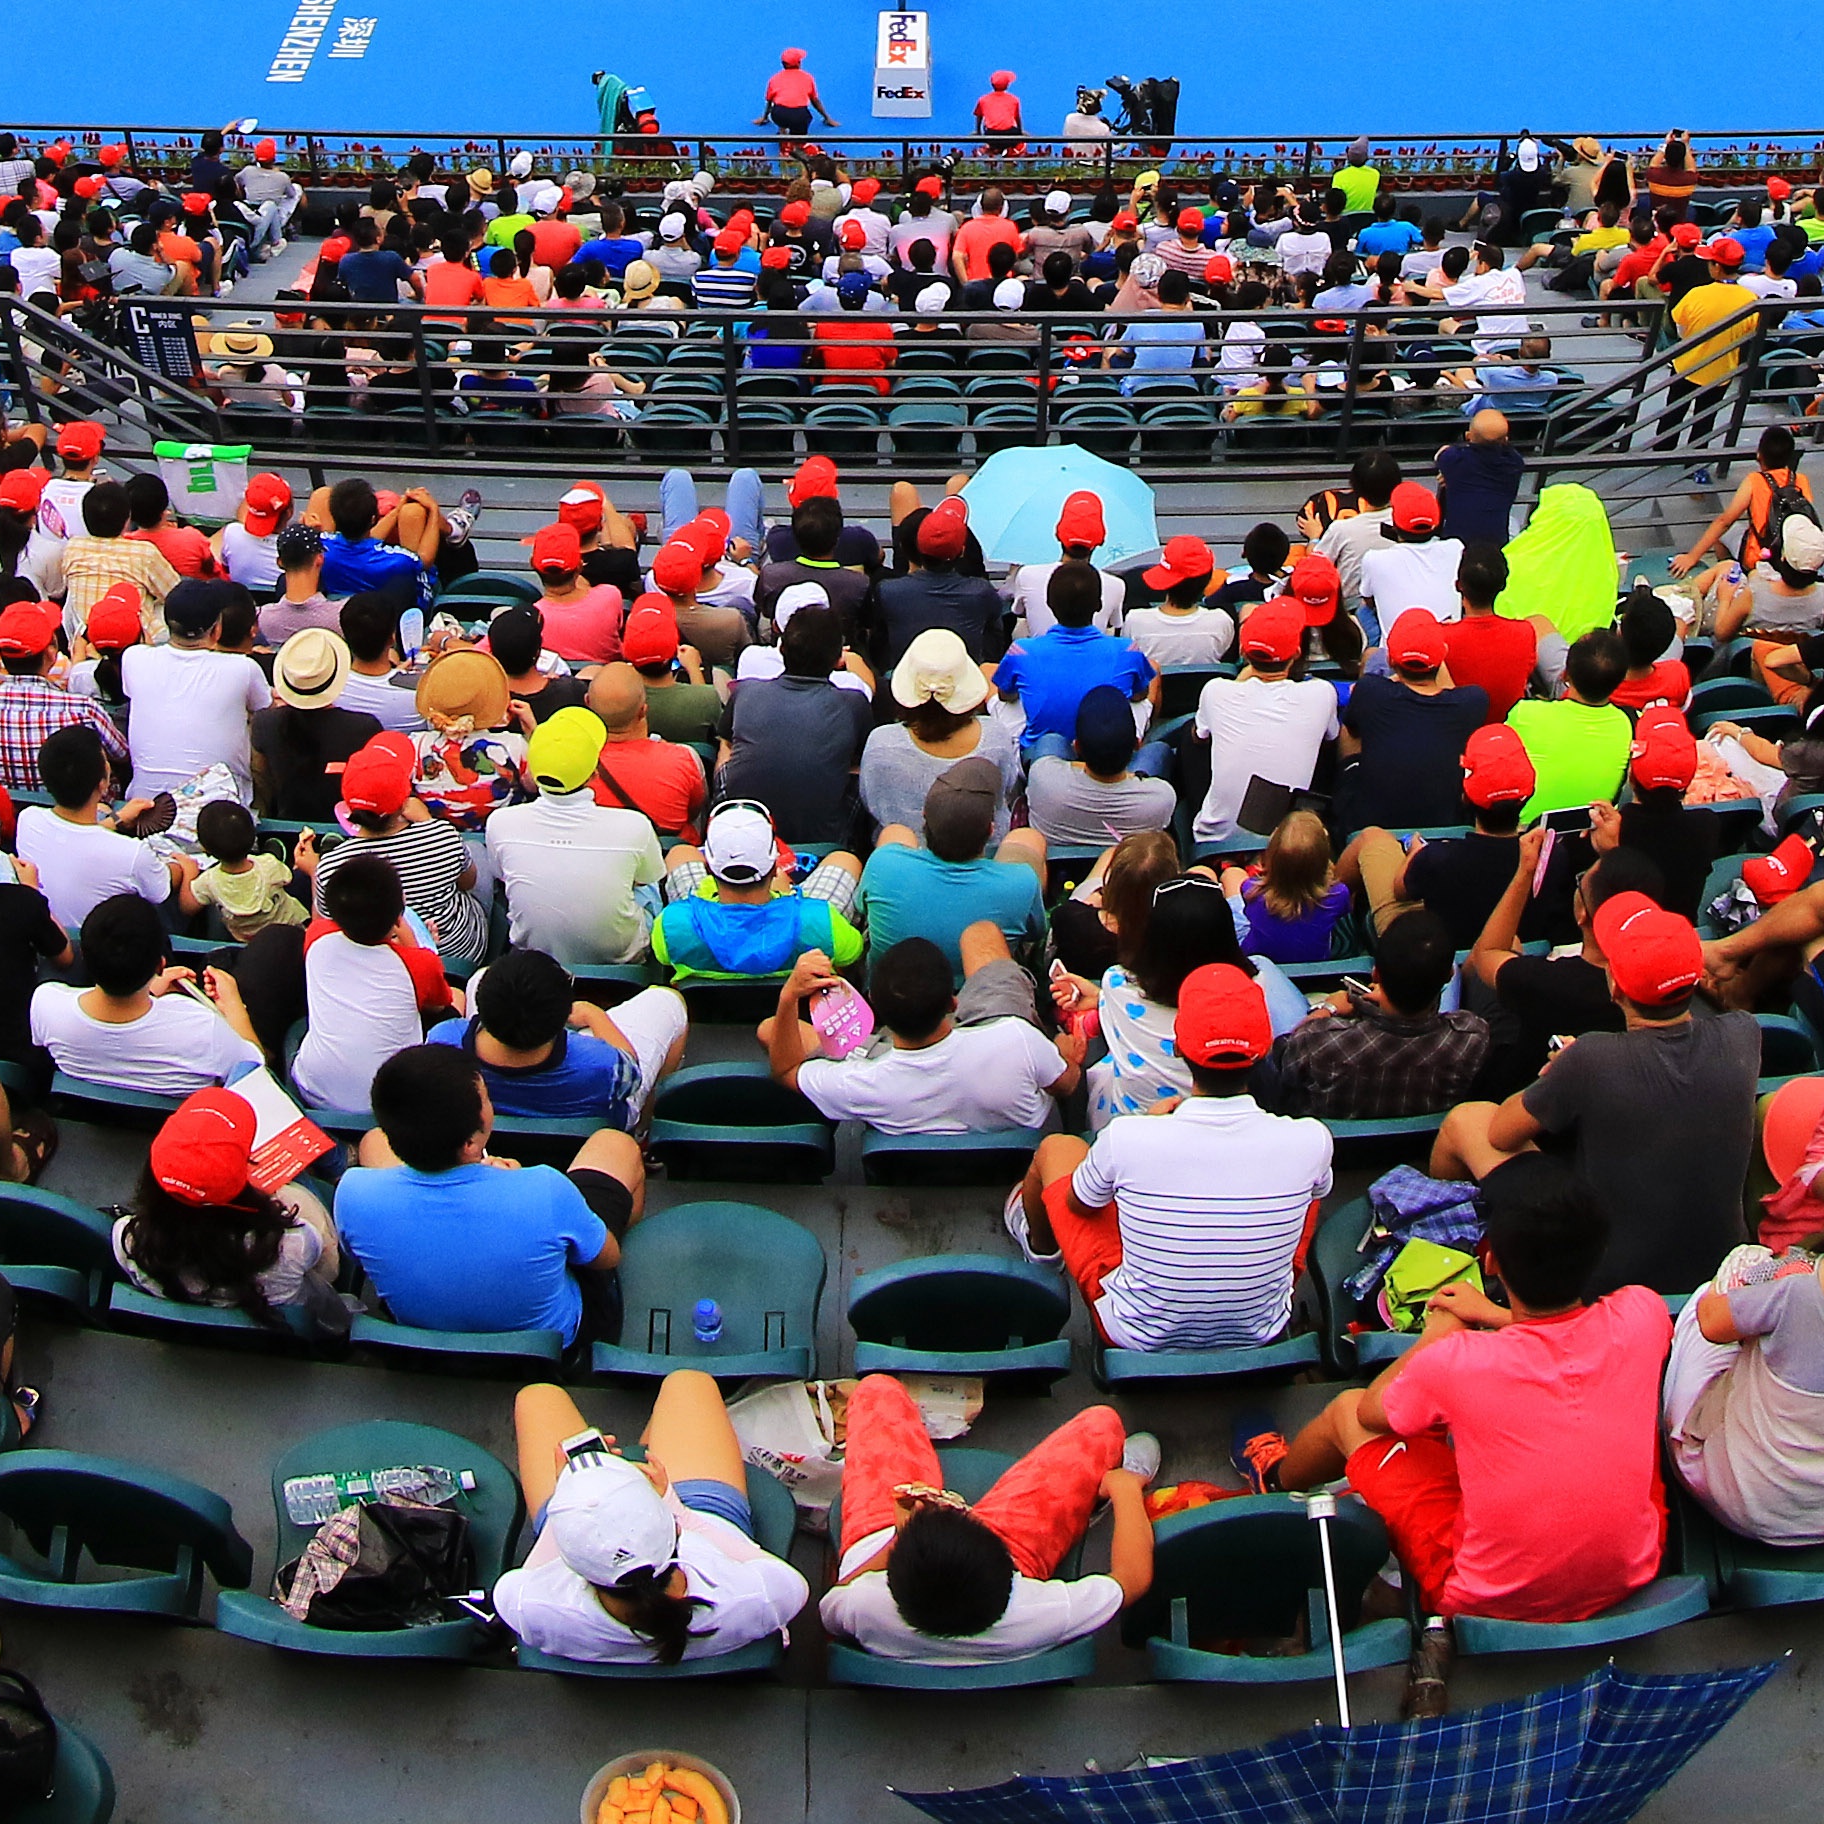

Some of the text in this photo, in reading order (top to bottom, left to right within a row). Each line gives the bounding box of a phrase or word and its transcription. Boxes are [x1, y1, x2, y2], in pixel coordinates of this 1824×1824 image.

[328, 16, 378, 60] 深圳
[887, 13, 918, 67] FedEx
[877, 86, 925, 100] FedEx
[130, 307, 149, 334] C
